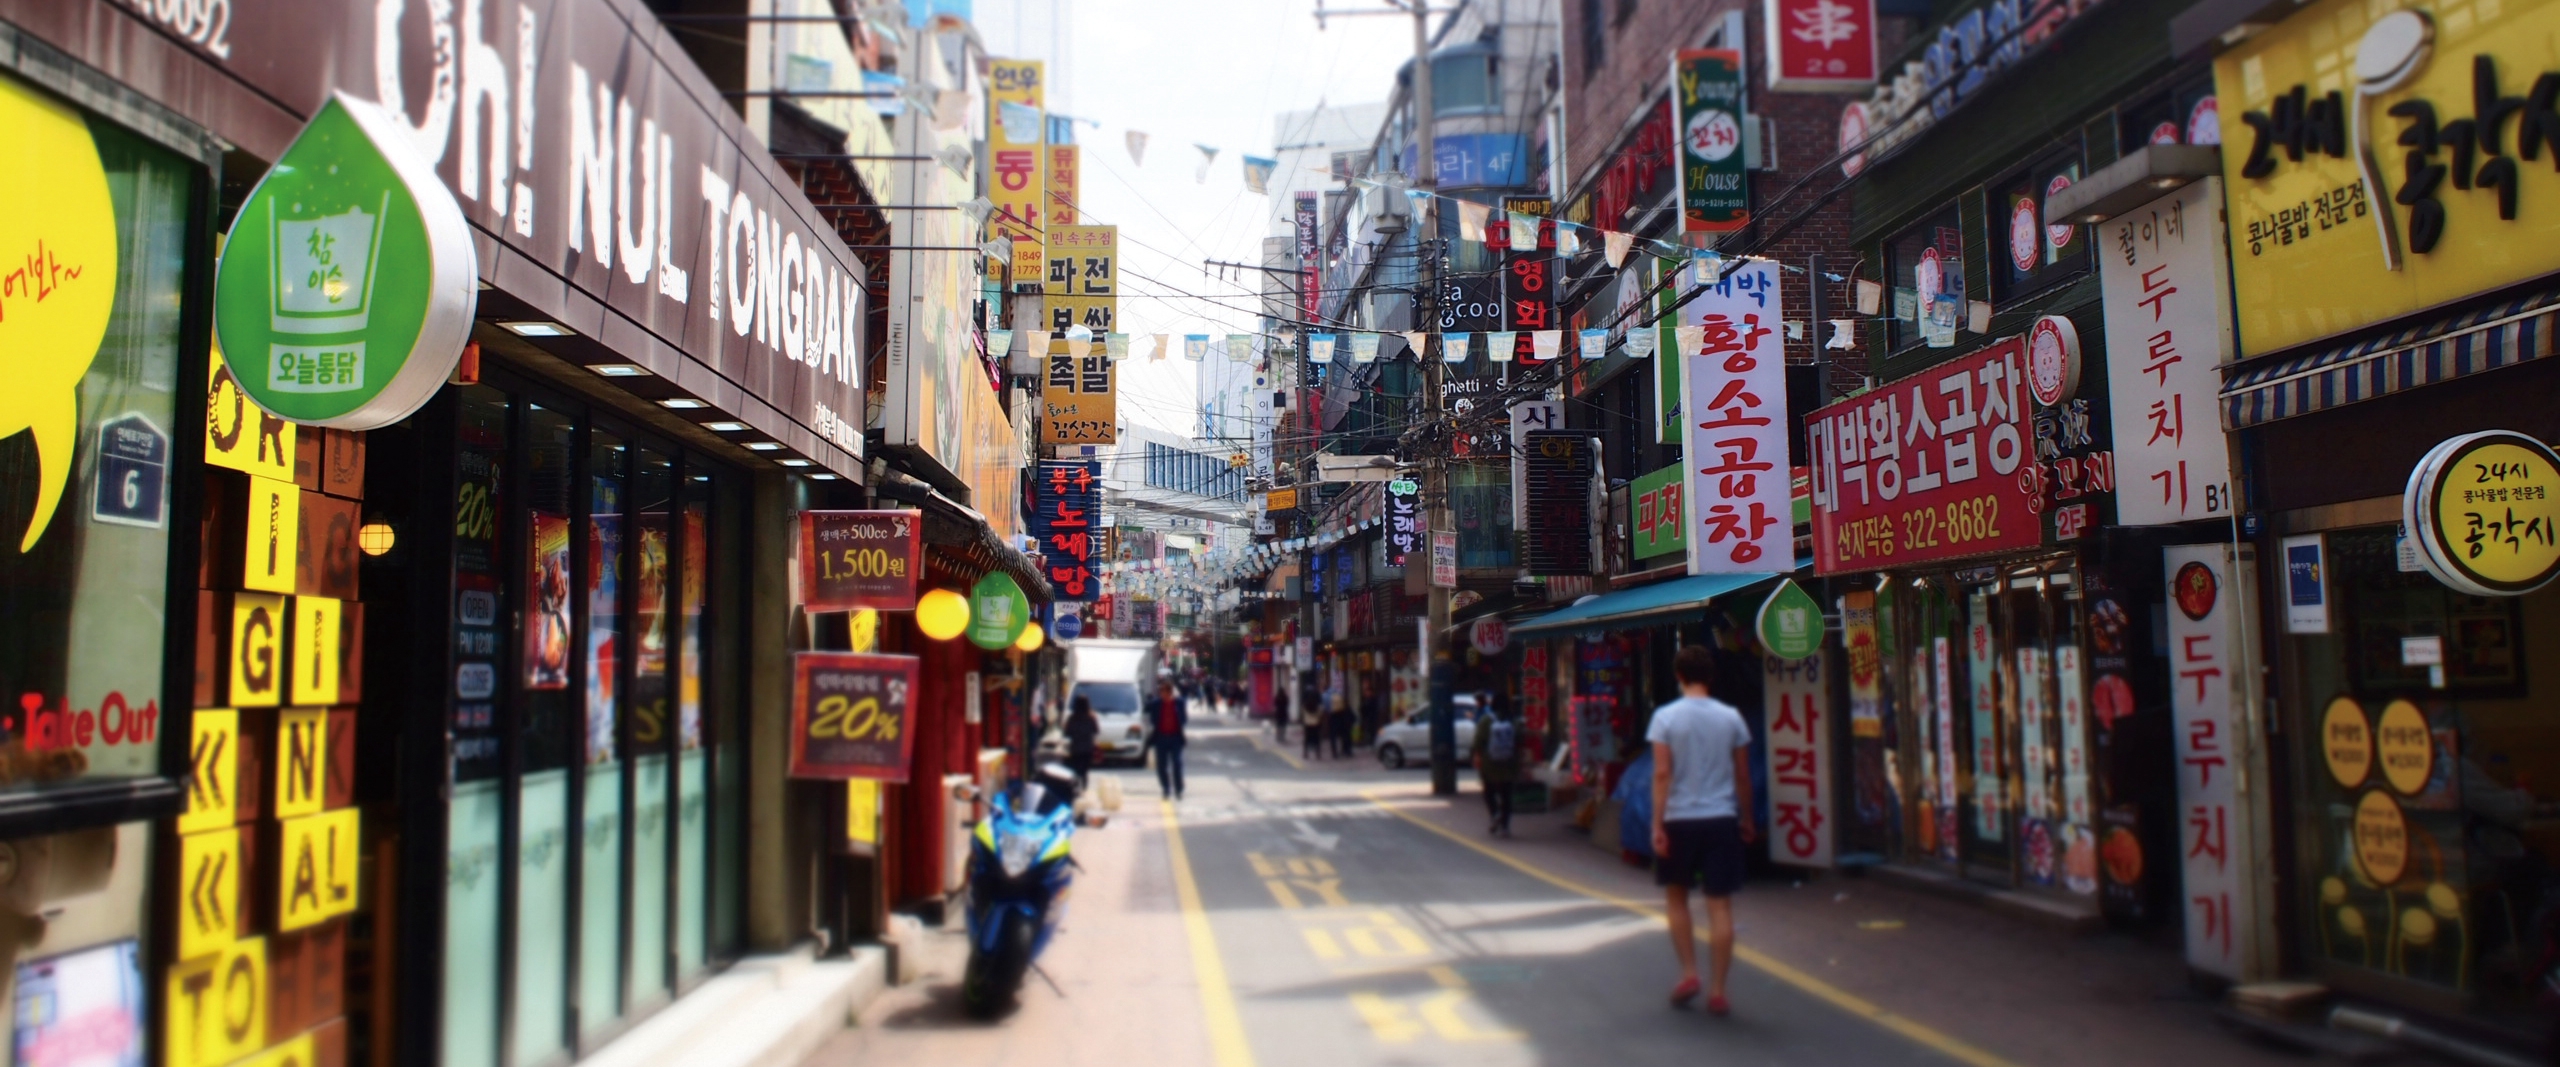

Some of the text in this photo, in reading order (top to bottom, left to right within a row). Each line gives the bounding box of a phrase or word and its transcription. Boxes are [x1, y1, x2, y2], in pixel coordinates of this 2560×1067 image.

[994, 66, 1038, 91] 연우
[1692, 123, 1735, 148] 꼬치
[1488, 152, 1511, 172] 4F
[1689, 165, 1739, 191] House
[376, 0, 858, 389] Oh! NUL TONGDAK
[2119, 200, 2184, 266] 철이네
[2248, 178, 2366, 256] 콩나물밥 전문점
[307, 228, 335, 265] 참
[1052, 232, 1111, 245] 민속주점
[0, 239, 82, 322] 어와~
[308, 269, 344, 304] 이슬
[1050, 257, 1110, 293] 파전
[1052, 307, 1111, 344] 보쌈
[276, 351, 357, 384] 오늘통닭
[1050, 355, 1111, 394] 족발
[2138, 264, 2188, 517] 두루치기
[1052, 421, 1111, 438] 김삿갓
[1700, 313, 1778, 564] 황소곱창
[1809, 352, 2022, 514] 대박황소곱창
[123, 469, 139, 509] 6
[2017, 451, 2114, 514] 양꼬치
[2475, 463, 2528, 483] 24시
[2206, 482, 2229, 513] B1
[2464, 485, 2545, 504] 콩나물밥 전문점
[820, 524, 888, 541] 생맥주 500cc
[1393, 497, 1415, 552] 노래방
[1838, 494, 2000, 561] 산지직송 322-8682
[2059, 508, 2082, 536] 2F
[2464, 507, 2554, 559] 콩각시
[821, 548, 905, 582] 1,500원
[1051, 500, 1091, 595] 노래방
[465, 597, 489, 618] OPEN
[460, 634, 472, 654] PM
[20, 689, 158, 750] Take Out
[809, 695, 898, 741] 20%
[1772, 693, 1823, 858] 사격장
[2179, 636, 2232, 964] 두루치기
